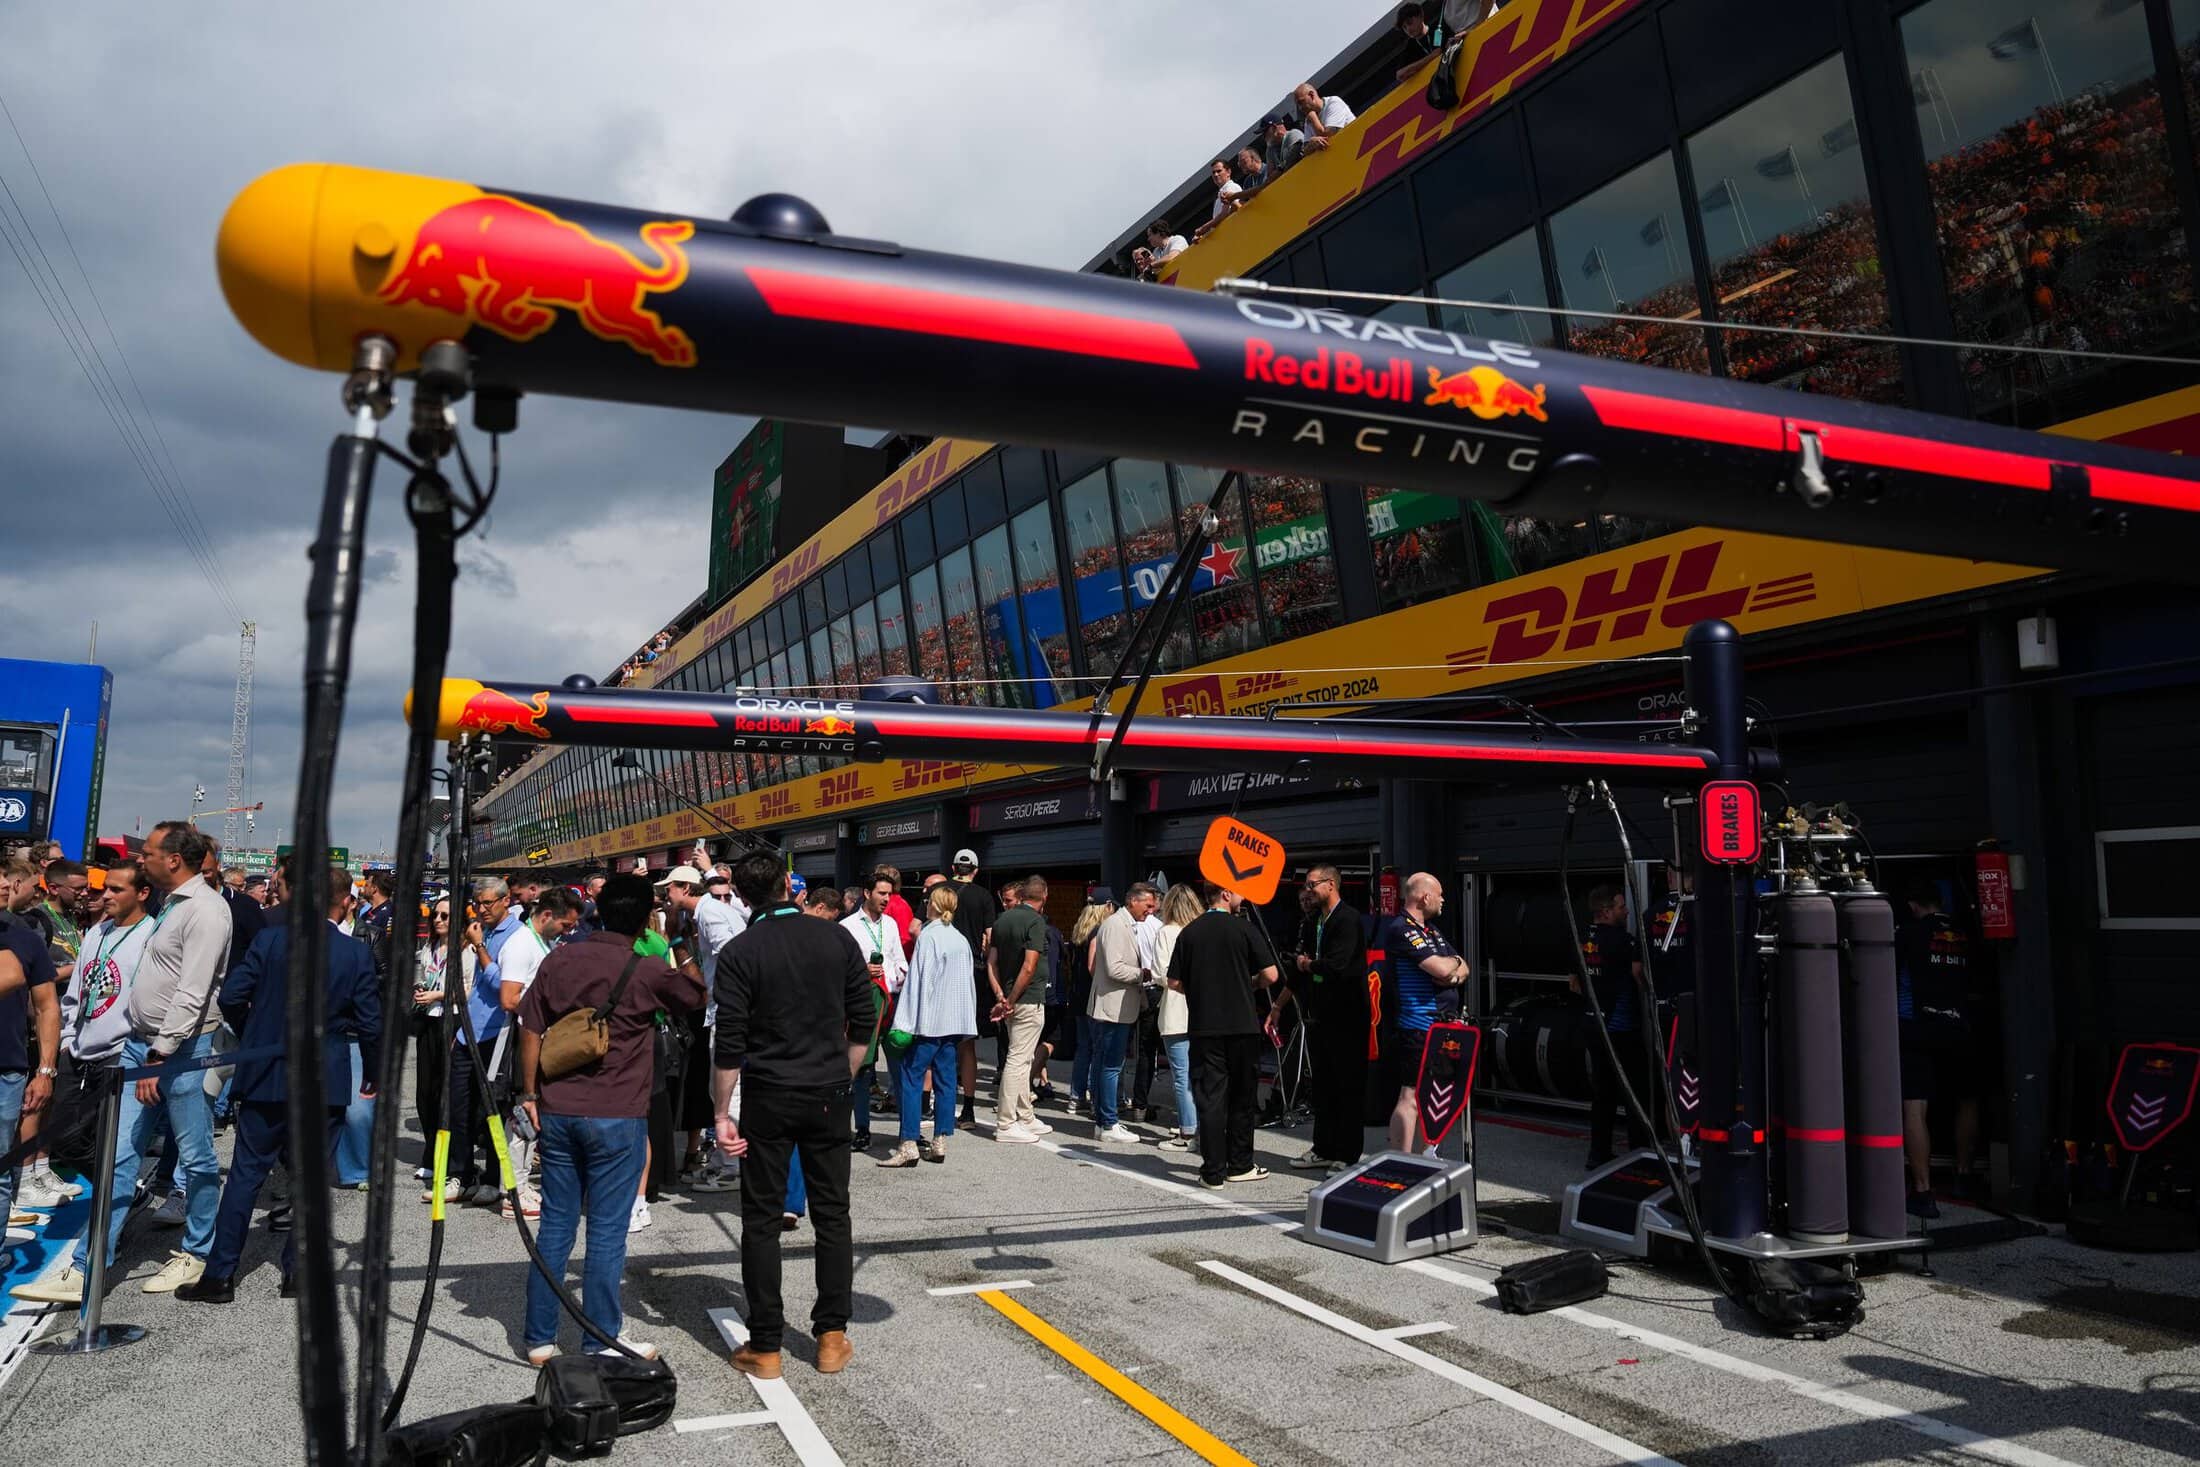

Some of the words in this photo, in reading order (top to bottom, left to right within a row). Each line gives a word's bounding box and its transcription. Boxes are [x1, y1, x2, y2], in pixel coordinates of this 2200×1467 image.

[1237, 299, 1541, 368] ORACLE
[1244, 337, 1329, 390] Red
[1335, 349, 1413, 403] Bull
[1232, 410, 1539, 472] RACING
[872, 438, 953, 528] DHL
[772, 539, 822, 601] DHL
[1483, 540, 1751, 665] DHL
[1236, 670, 1288, 699] DHL
[1306, 685, 1340, 704] STOP
[1343, 677, 1380, 699] 2024
[736, 698, 856, 714] ORACLE
[1638, 690, 1687, 711] ORAC
[735, 715, 768, 732] Red
[769, 716, 800, 734] Bull
[734, 739, 855, 751] RACING
[819, 770, 865, 807] DHL
[1188, 776, 1220, 797] MAX
[759, 789, 794, 820] DHL
[1003, 804, 1032, 820] SERGIO
[1033, 799, 1061, 816] PEREZ
[1721, 793, 1739, 851] BRAKES
[1227, 826, 1270, 857] BRAKES
